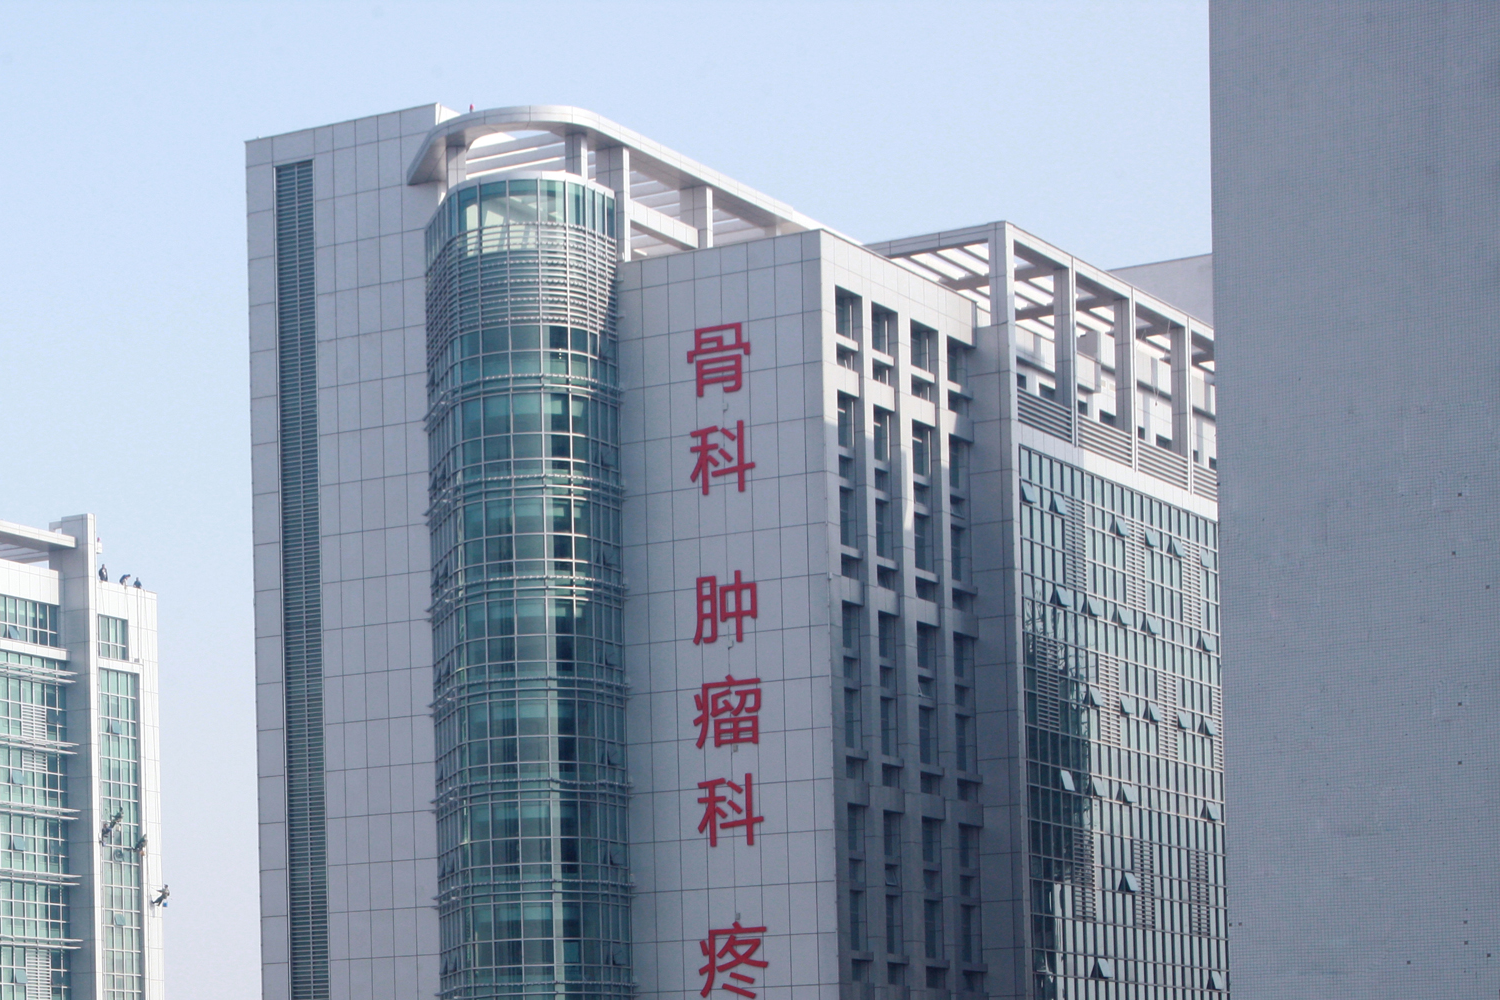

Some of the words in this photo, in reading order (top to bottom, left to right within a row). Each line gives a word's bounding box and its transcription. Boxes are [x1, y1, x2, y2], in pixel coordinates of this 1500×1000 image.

[687, 323, 755, 495] 骨科
[694, 570, 764, 847] 肿瘤科
